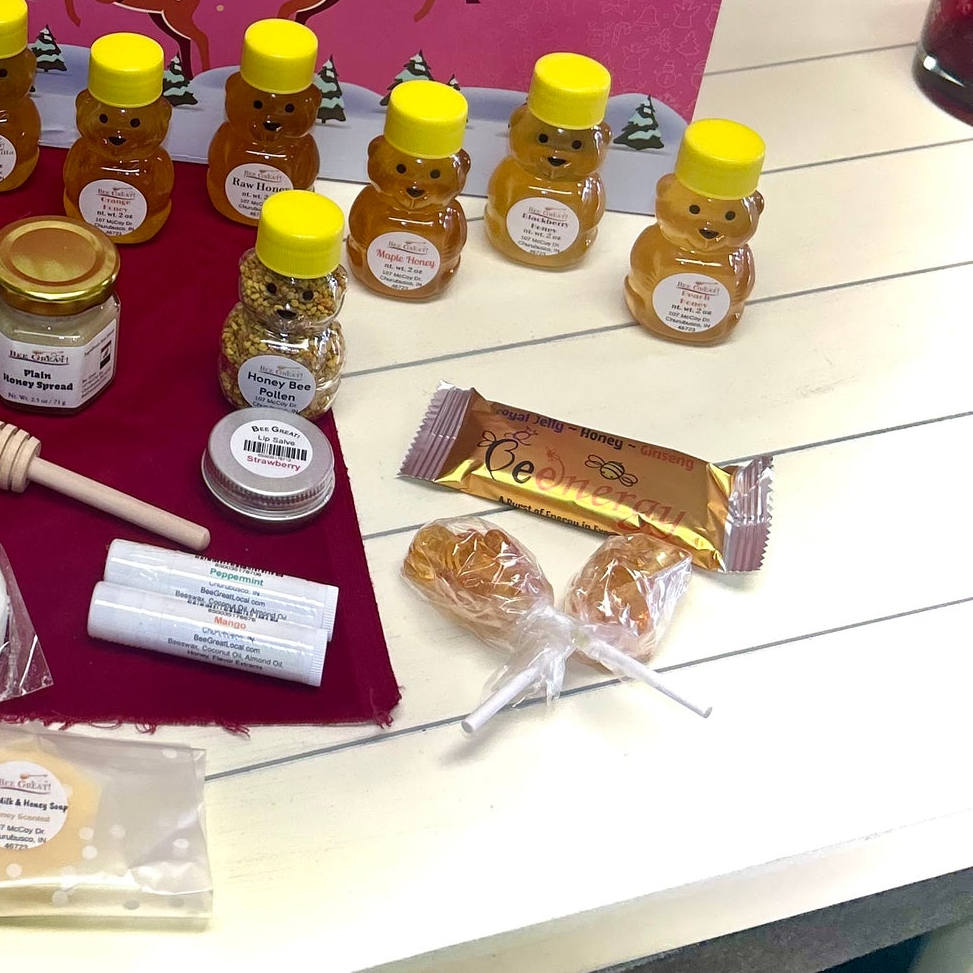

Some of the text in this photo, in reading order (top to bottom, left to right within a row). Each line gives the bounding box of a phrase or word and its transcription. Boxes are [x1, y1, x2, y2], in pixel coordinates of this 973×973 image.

[233, 177, 254, 188] Raw
[376, 249, 436, 269] Maple Honey
[24, 369, 51, 379] Plain
[248, 371, 311, 391] Honey Bee
[3, 373, 73, 391] Honey Spread
[259, 387, 295, 401] Pollen
[272, 426, 300, 439] GREAT!
[273, 437, 295, 446] Salve
[534, 412, 564, 433] Jelly
[580, 428, 623, 450] Honey
[641, 445, 695, 471] Ginseng
[247, 455, 300, 471] Strawberry
[210, 568, 264, 586] Peppermint
[214, 616, 246, 629] Mango
[194, 634, 261, 654] BeeGreatLocal.com
[168, 637, 199, 651] Beeswax,
[202, 645, 230, 656] Coconut
[245, 655, 271, 666] Almond
[24, 799, 47, 810] Honey
[49, 802, 68, 813] Soap
[18, 812, 50, 822] Scented
[7, 825, 33, 834] McCoy
